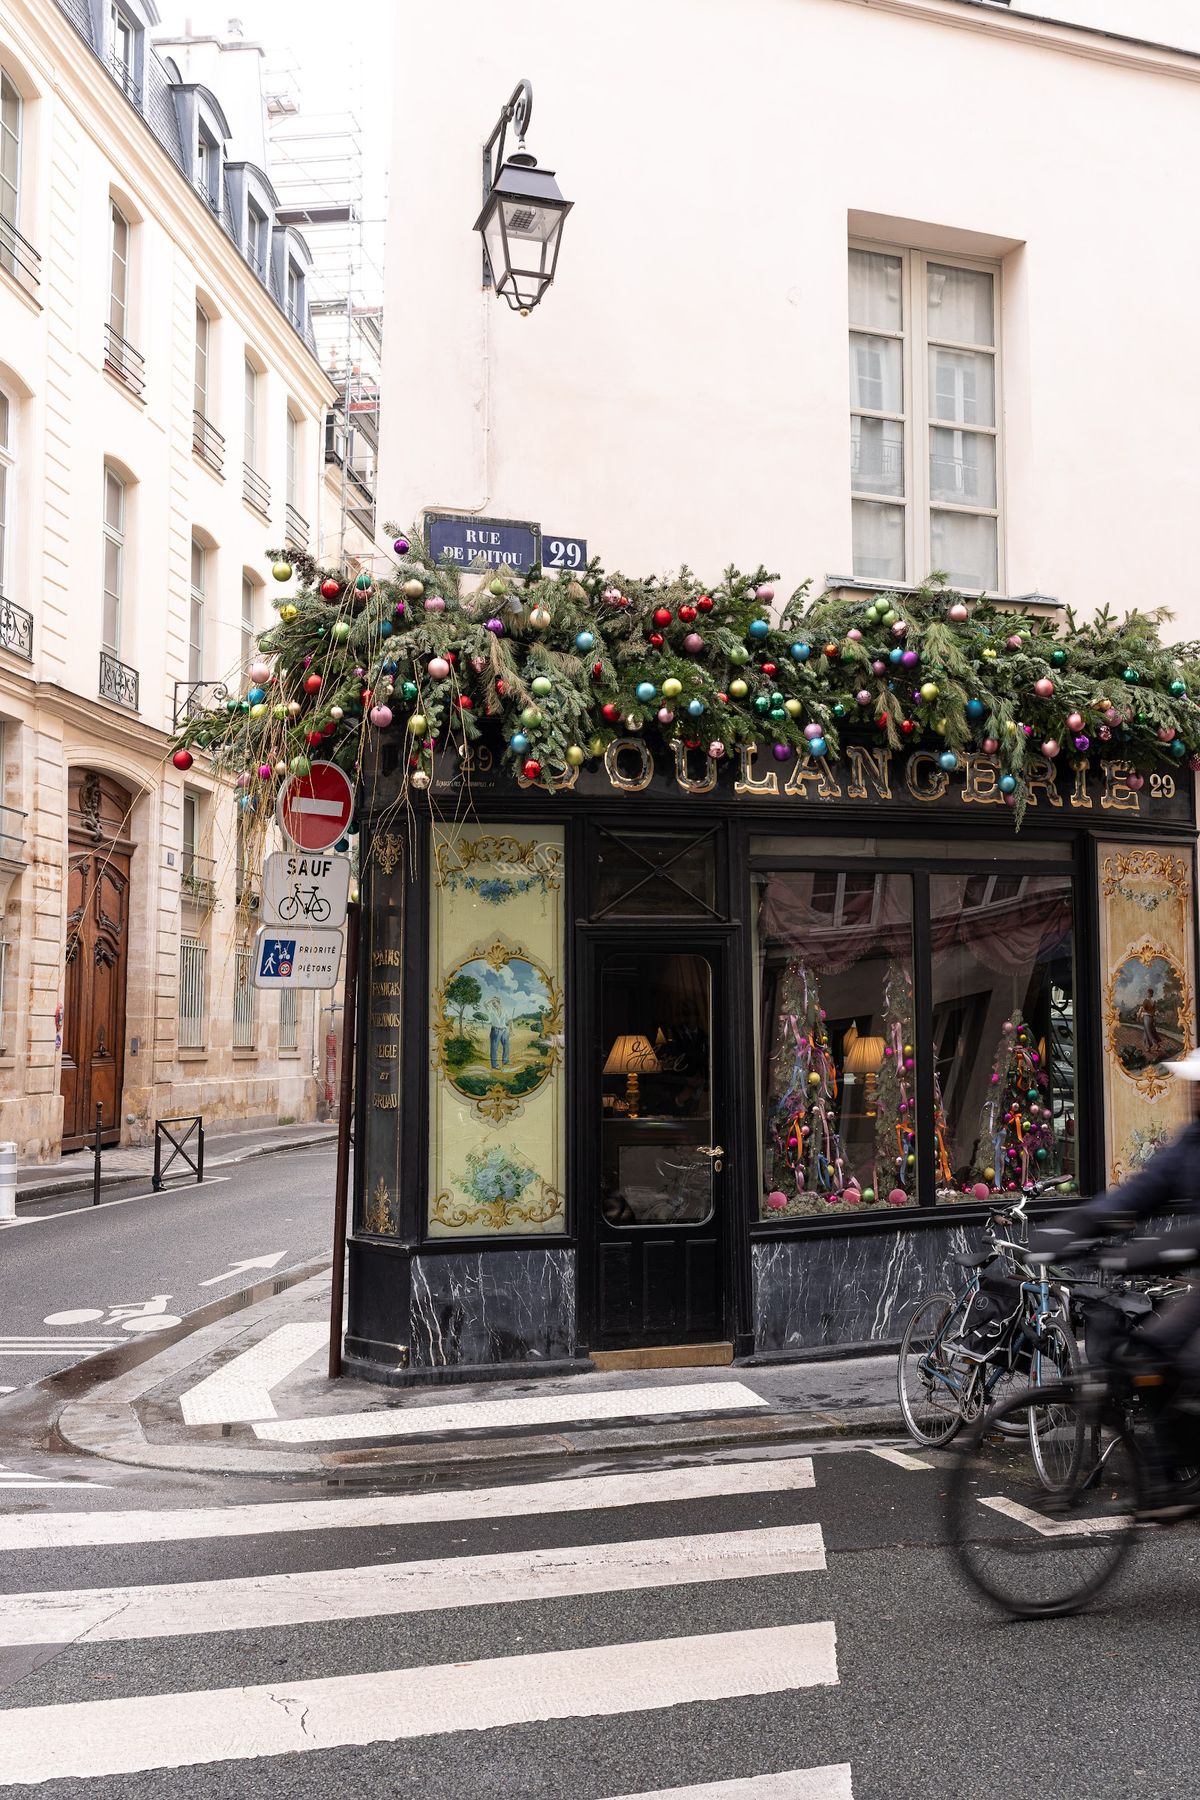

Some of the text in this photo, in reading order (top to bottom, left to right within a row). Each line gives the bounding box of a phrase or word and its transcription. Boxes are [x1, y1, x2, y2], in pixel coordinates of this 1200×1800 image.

[466, 529, 501, 545] RUE
[443, 545, 523, 566] DE POITOU
[549, 541, 582, 567] 29
[1149, 773, 1176, 799] 29
[286, 858, 332, 877] SAUF
[299, 945, 337, 954] PRIORITÉ
[373, 949, 400, 967] PAINS
[298, 964, 332, 972] PIÉTONS
